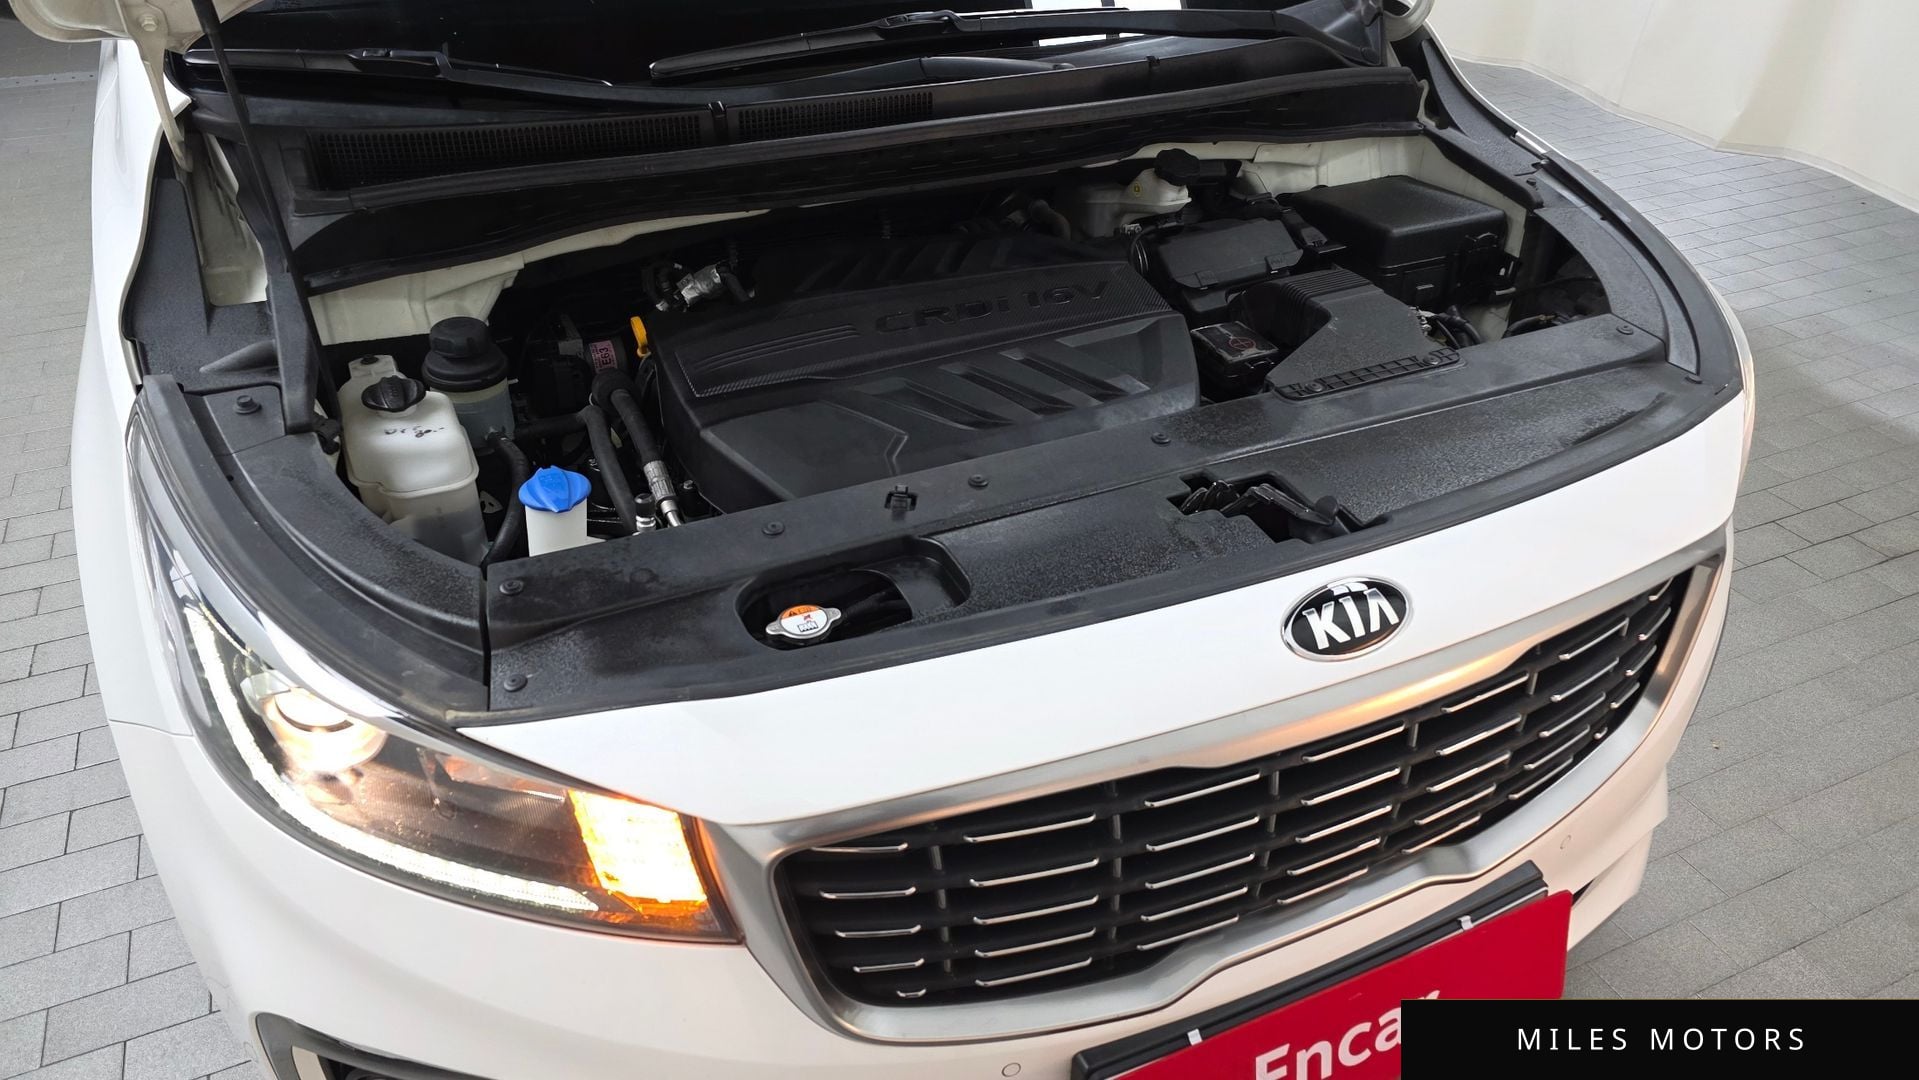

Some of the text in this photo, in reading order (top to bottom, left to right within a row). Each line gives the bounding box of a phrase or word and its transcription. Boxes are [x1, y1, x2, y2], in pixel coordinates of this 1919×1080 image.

[1022, 281, 1109, 309] 16V
[1302, 587, 1399, 650] KIA
[1256, 990, 1440, 1080] Enca
